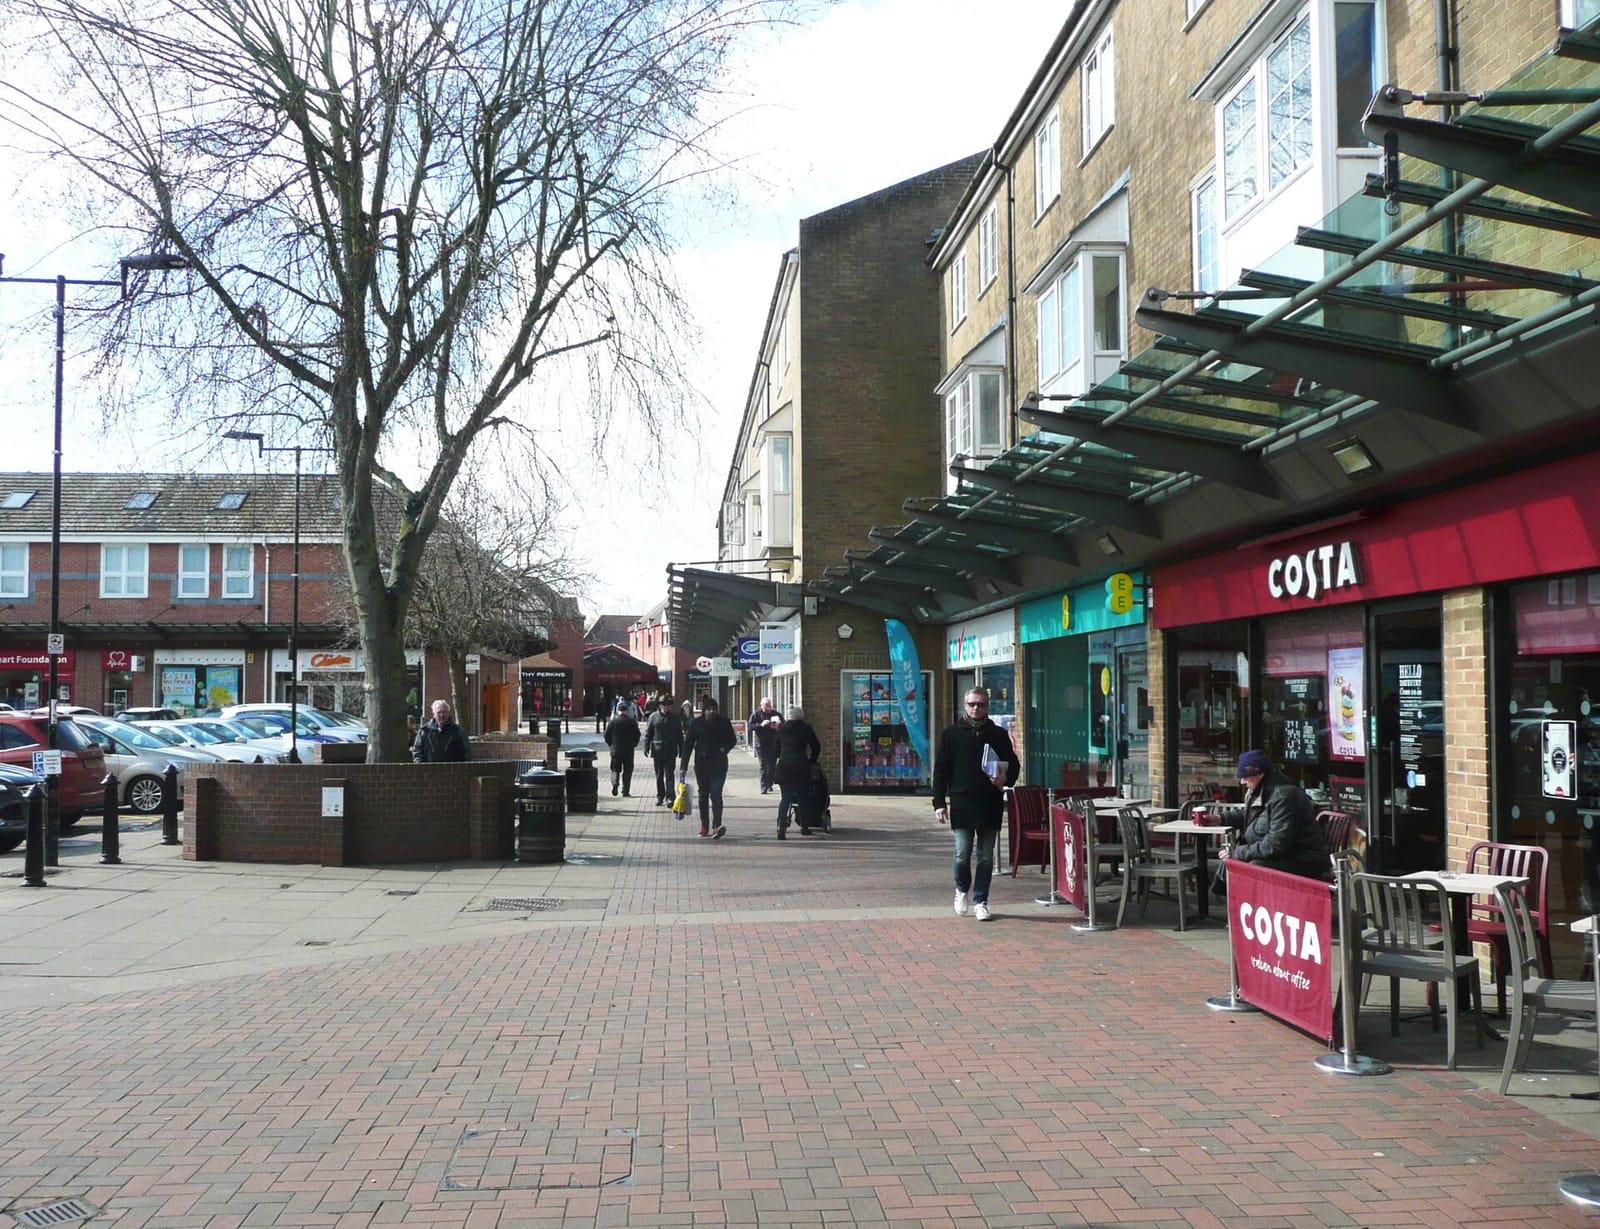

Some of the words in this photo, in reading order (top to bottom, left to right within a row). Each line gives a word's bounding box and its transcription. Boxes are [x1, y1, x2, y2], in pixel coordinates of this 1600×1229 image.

[1268, 541, 1357, 600] COSTA
[763, 641, 792, 650] savers
[947, 627, 977, 664] savers
[0, 656, 15, 664] art
[16, 655, 67, 664] Foundaon
[1399, 664, 1422, 679] HELLO
[1340, 747, 1358, 756] COSTA
[1240, 902, 1321, 965] COSTA
